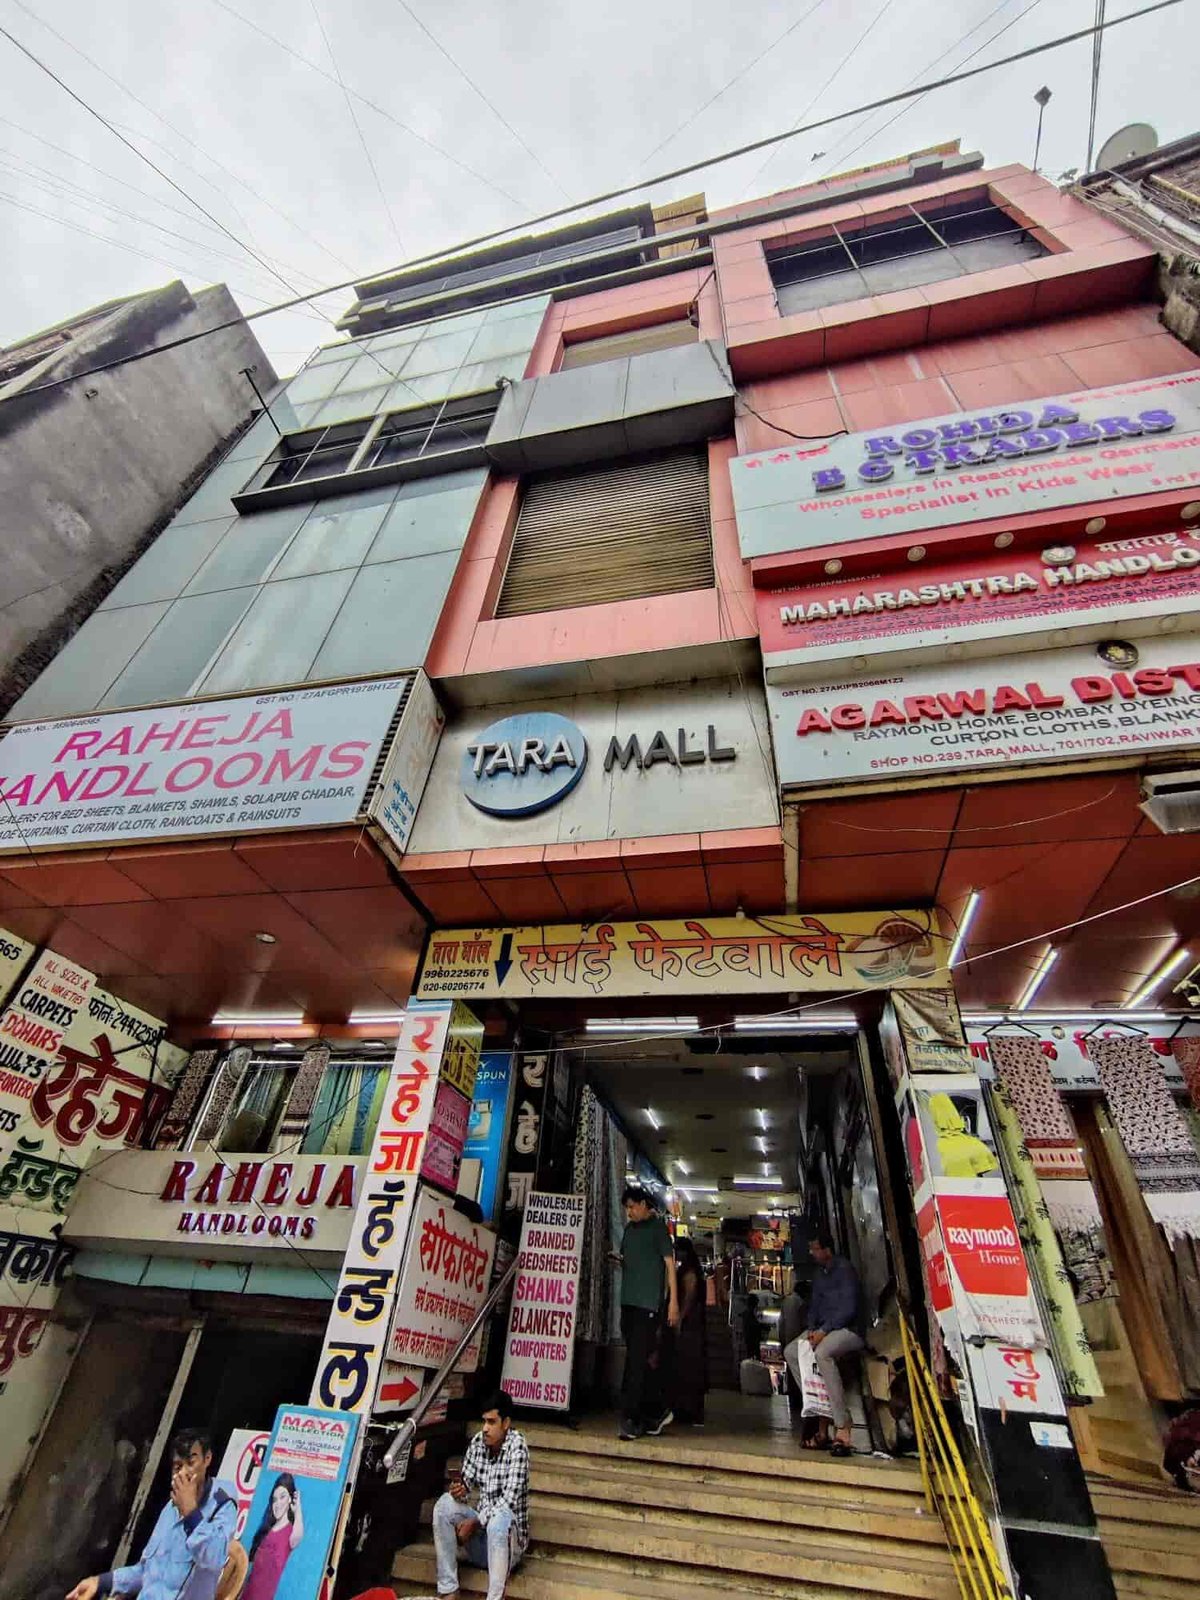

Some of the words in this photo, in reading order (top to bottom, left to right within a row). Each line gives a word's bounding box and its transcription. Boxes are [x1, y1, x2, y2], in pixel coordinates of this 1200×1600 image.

[864, 403, 1080, 459] ROHIDA
[905, 409, 1176, 475] TRADERS
[799, 484, 927, 513] Wholesalers
[958, 455, 1093, 485] Readymade
[860, 486, 980, 519] Specialist
[1018, 474, 1079, 493] Kids
[779, 572, 1039, 626] MAHARASHTRA
[256, 695, 276, 705] GST
[796, 682, 1065, 737] AGARWAL
[52, 708, 294, 764] RAHEJA
[853, 721, 952, 743] RAYMOND
[929, 727, 1018, 747] CURTON
[467, 733, 578, 779] TARA
[603, 724, 737, 773] MALL
[869, 756, 909, 769] SHOP
[38, 811, 61, 821] FOR
[61, 809, 84, 820] BED
[241, 791, 299, 806] SOLAPUR
[71, 821, 119, 834] CURTAIN
[158, 812, 226, 829] RAINCOATS
[226, 813, 236, 823] &
[237, 807, 302, 823] RAINSUITS
[629, 916, 846, 982] फेटेवाले
[20, 989, 78, 1027] CARPETS
[1, 1012, 65, 1054] DOHARS
[477, 1070, 507, 1081] SPUN
[160, 1160, 355, 1209] RAHEJA
[528, 1193, 583, 1212] WHOLESALE
[176, 1212, 317, 1240] HANDLOOMS
[525, 1210, 568, 1228] DEALERS
[570, 1214, 583, 1228] OF
[527, 1230, 576, 1251] BRANDED
[946, 1226, 1017, 1250] Raymond
[518, 1251, 578, 1275] BEDSHEETS
[978, 1249, 1020, 1265] Home
[515, 1275, 576, 1306] SHAWLS
[510, 1306, 573, 1338] BLANKETS
[509, 1338, 568, 1362] COMFORTERS
[531, 1360, 539, 1379] &
[501, 1378, 542, 1402] WEDDING
[543, 1383, 567, 1404] SETS
[281, 1425, 345, 1439] COLLECTION
[283, 1416, 344, 1433] MAYA
